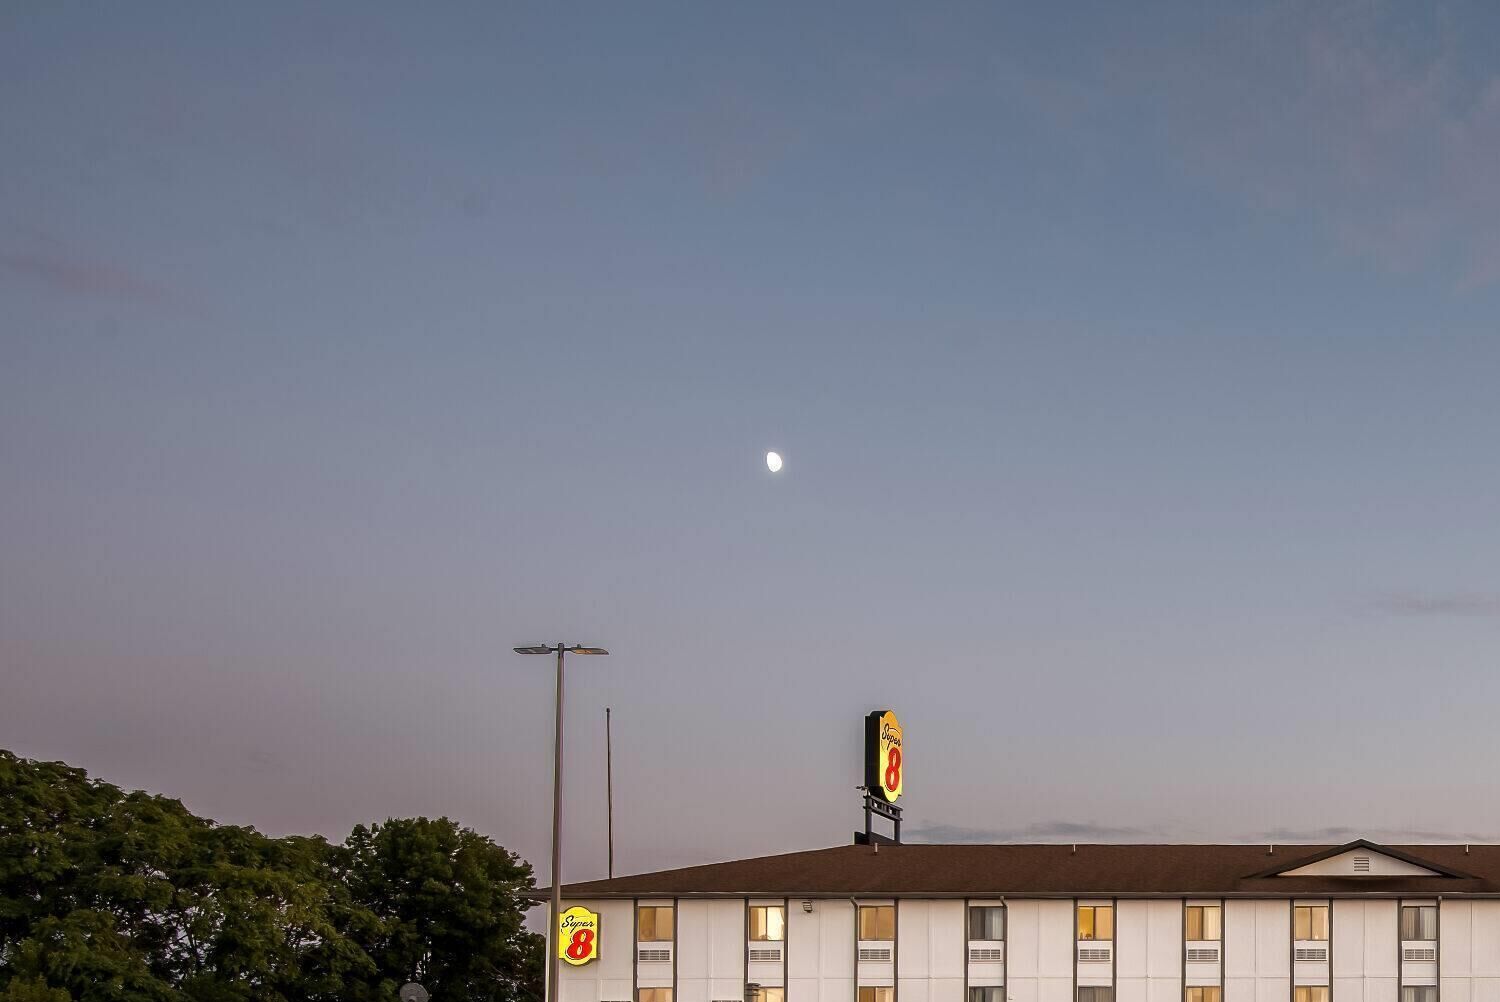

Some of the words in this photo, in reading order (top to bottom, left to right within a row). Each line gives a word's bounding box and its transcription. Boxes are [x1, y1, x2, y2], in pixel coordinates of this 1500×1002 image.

[881, 723, 901, 750] Super
[884, 747, 901, 792] 8
[561, 915, 595, 934] Super
[565, 928, 595, 960] 8
